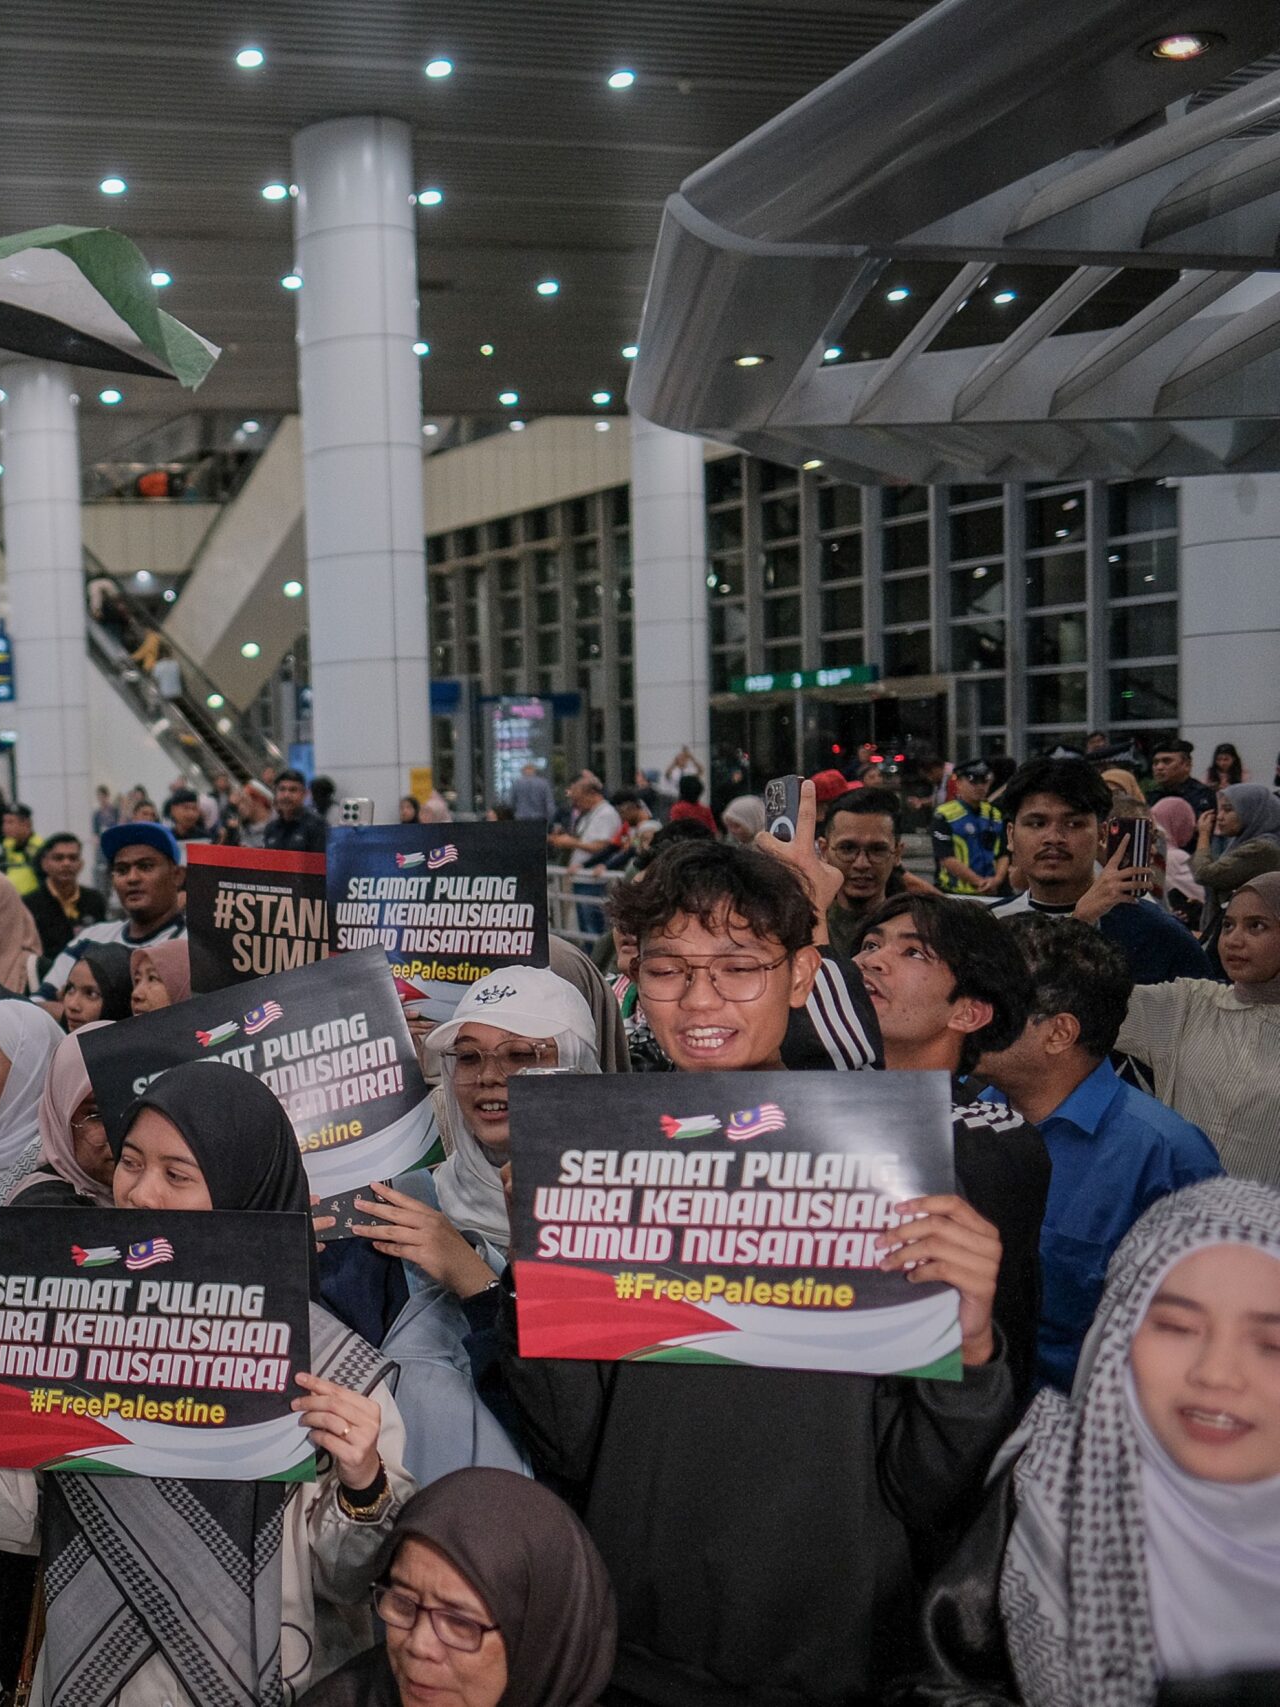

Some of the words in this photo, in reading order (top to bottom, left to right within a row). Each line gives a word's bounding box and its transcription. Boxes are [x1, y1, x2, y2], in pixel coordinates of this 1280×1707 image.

[347, 875, 432, 901] SELAMAT
[433, 875, 517, 901] PULANG
[336, 903, 380, 926] WIRA
[383, 902, 534, 929] KEMANUSIAAN
[401, 929, 534, 955] NUSANTARA!
[262, 1012, 369, 1067] PULANG
[260, 1036, 397, 1095] ANUSIAAN
[559, 1150, 735, 1187] SELAMAT
[742, 1151, 899, 1190] PULANG
[534, 1186, 634, 1223] WIRA
[640, 1188, 926, 1229] KEMANUSIAA
[538, 1225, 673, 1262] SUMUD
[137, 1280, 265, 1318] PULANG
[616, 1272, 854, 1308] #FreePalestine
[52, 1312, 291, 1356] KEMANUSIAAN
[84, 1349, 291, 1392] NUSANTARA!
[31, 1388, 227, 1425] #FreePalestine
